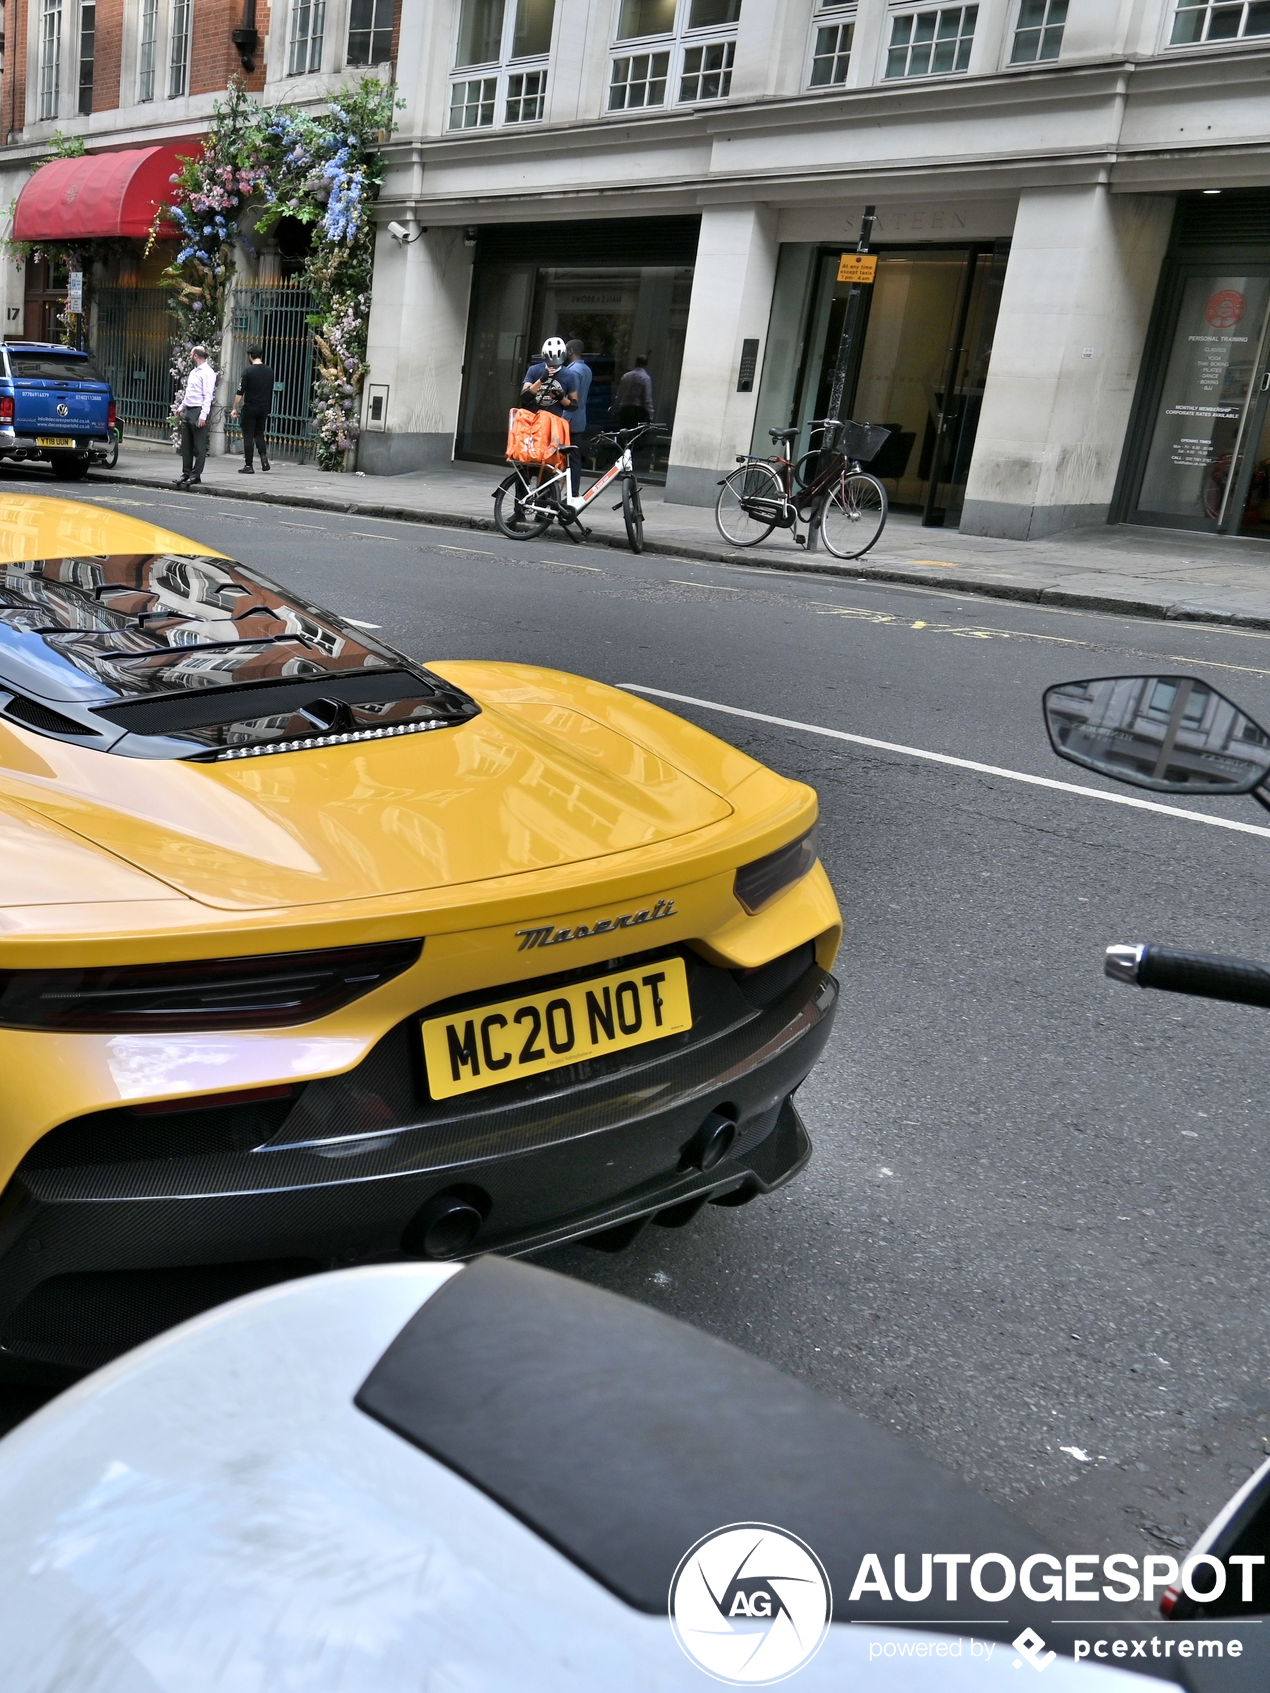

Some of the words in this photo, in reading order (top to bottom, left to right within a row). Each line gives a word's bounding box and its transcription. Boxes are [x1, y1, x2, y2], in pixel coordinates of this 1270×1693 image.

[7, 307, 20, 321] 17
[515, 898, 678, 951] Maserati
[445, 997, 576, 1082] MC20
